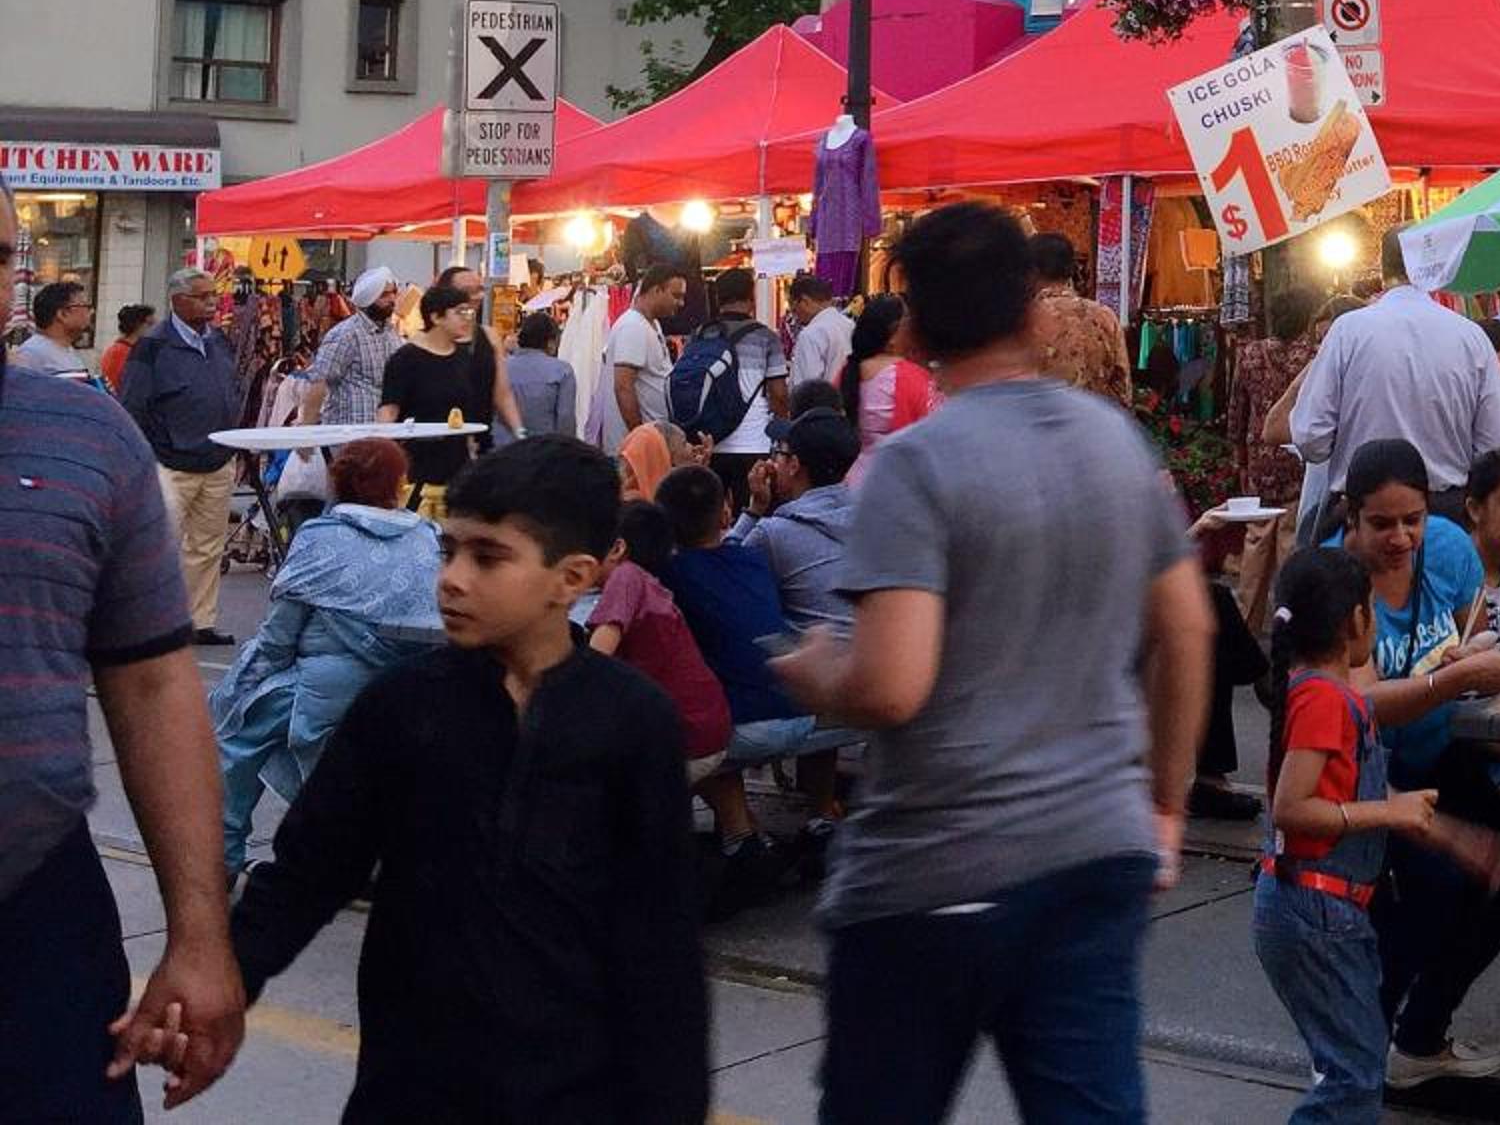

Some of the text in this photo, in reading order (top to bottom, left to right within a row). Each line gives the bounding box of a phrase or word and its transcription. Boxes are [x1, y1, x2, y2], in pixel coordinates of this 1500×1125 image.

[471, 12, 553, 32] PEDESTRIAN
[1345, 54, 1363, 70] NO
[1187, 57, 1277, 104] ICE GOLA
[1201, 88, 1272, 129] CHUSKI
[479, 123, 541, 140] STOP FOR
[0, 147, 213, 173] ITCHEN WARE
[466, 148, 551, 166] PEDESTRIANS
[31, 173, 105, 188] Equipments
[122, 175, 177, 186] Tandoors
